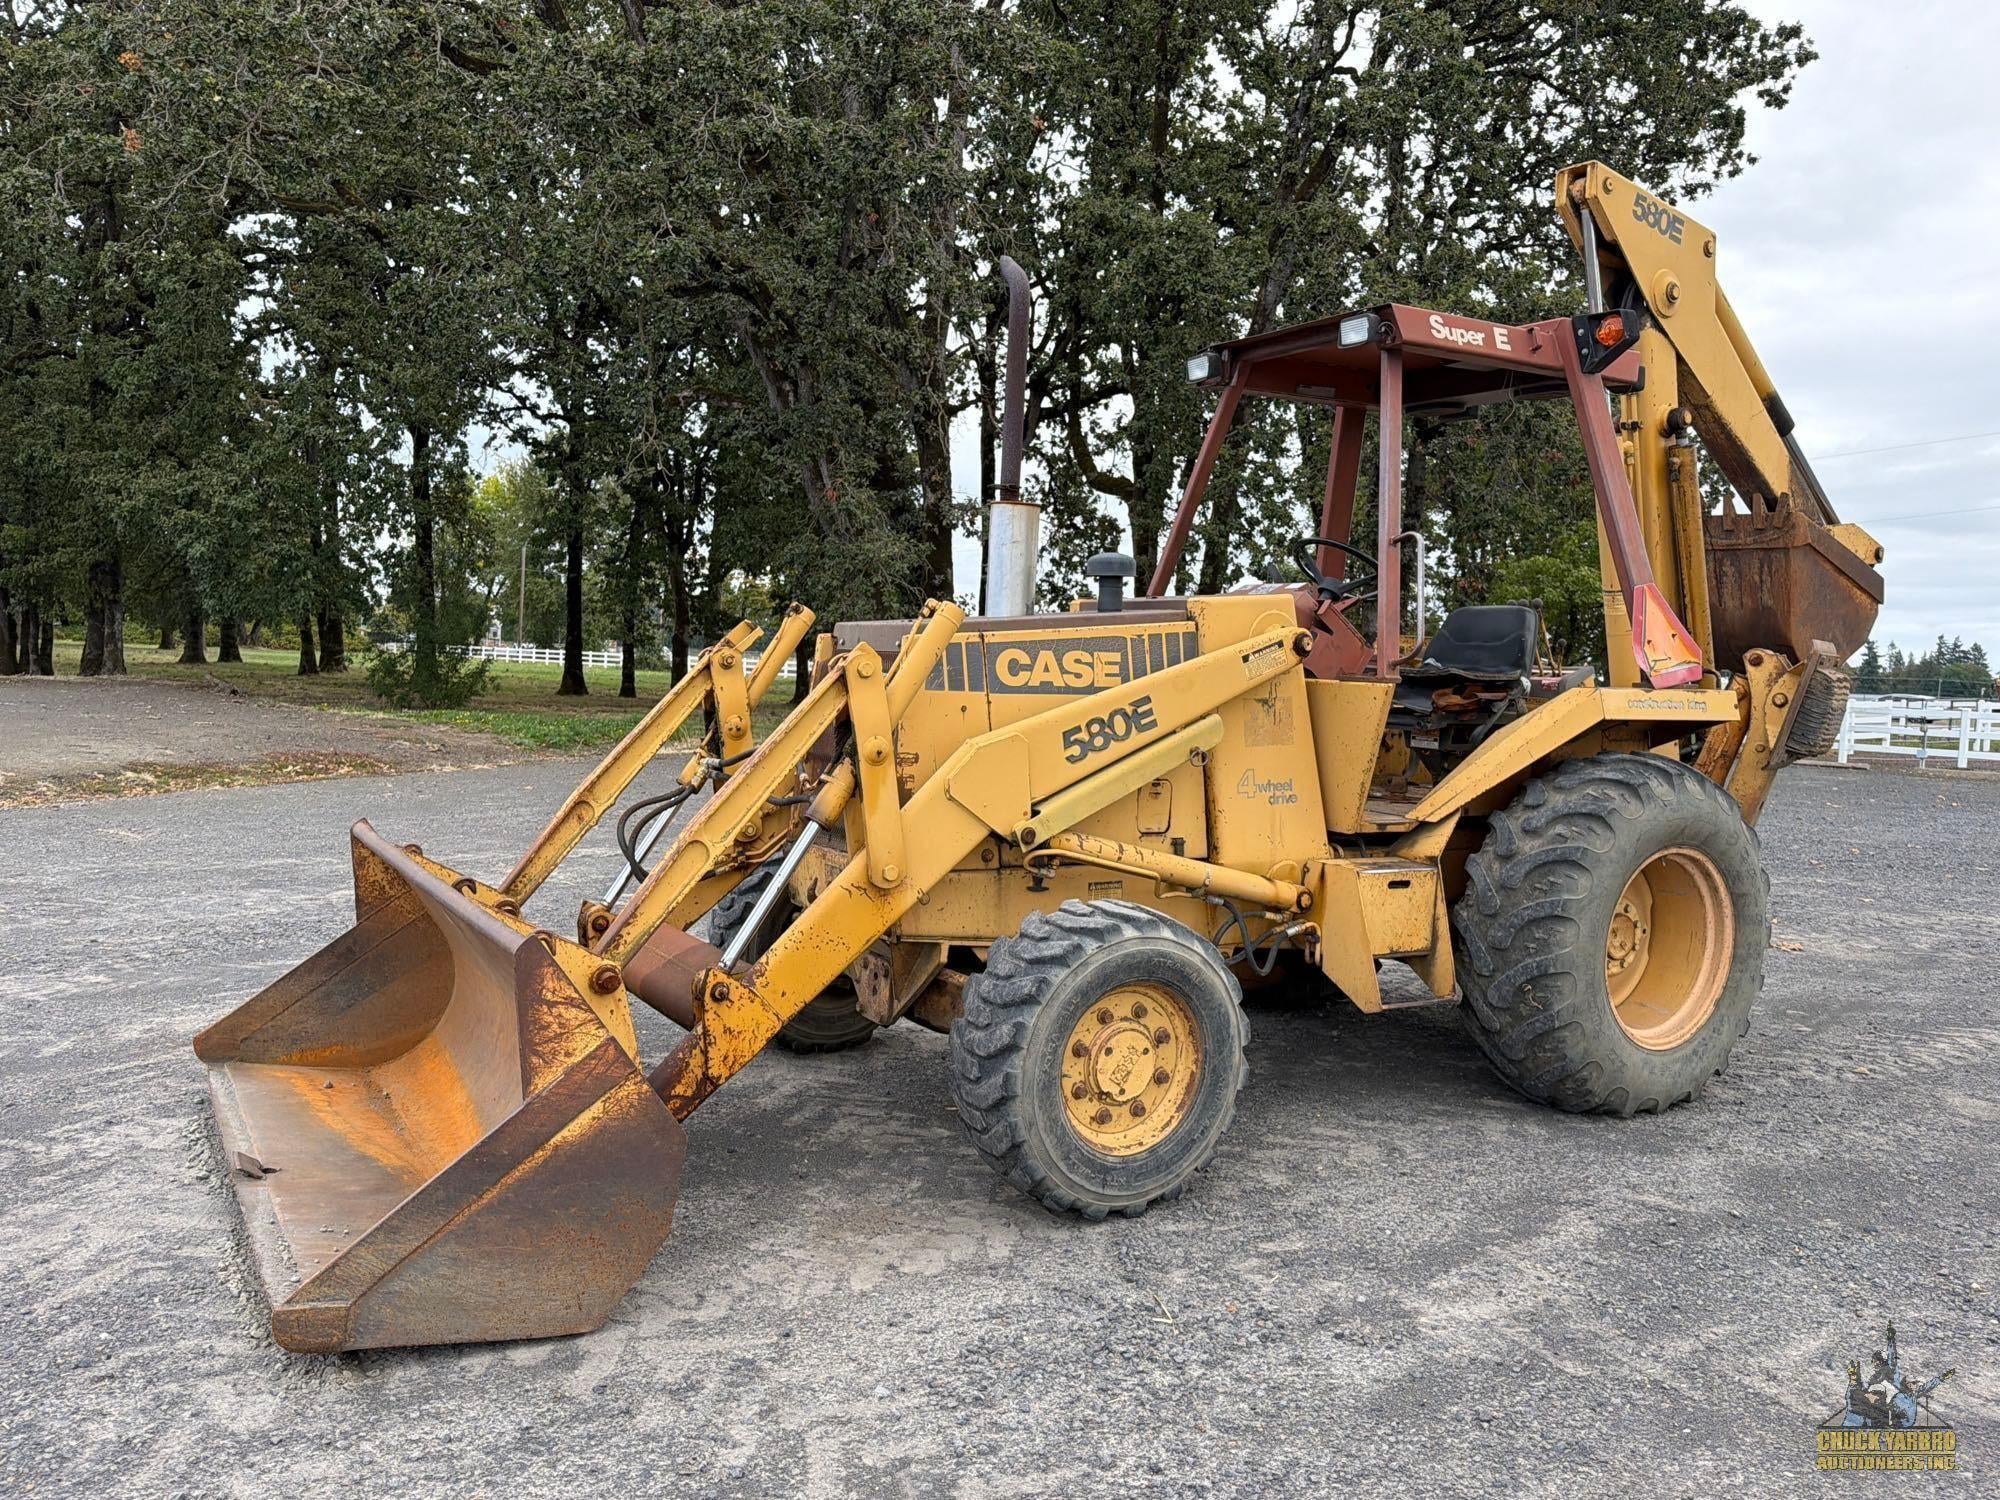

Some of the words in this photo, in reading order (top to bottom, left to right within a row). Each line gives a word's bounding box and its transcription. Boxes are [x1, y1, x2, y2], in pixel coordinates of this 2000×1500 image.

[1632, 192, 1685, 246] 580E
[1429, 314, 1486, 347] Super
[1494, 327, 1511, 351] E
[995, 648, 1122, 688] CASE
[1062, 694, 1158, 764] 580E
[1237, 768, 1257, 799] 4
[1256, 778, 1293, 793] wheel
[1268, 792, 1298, 806] drive
